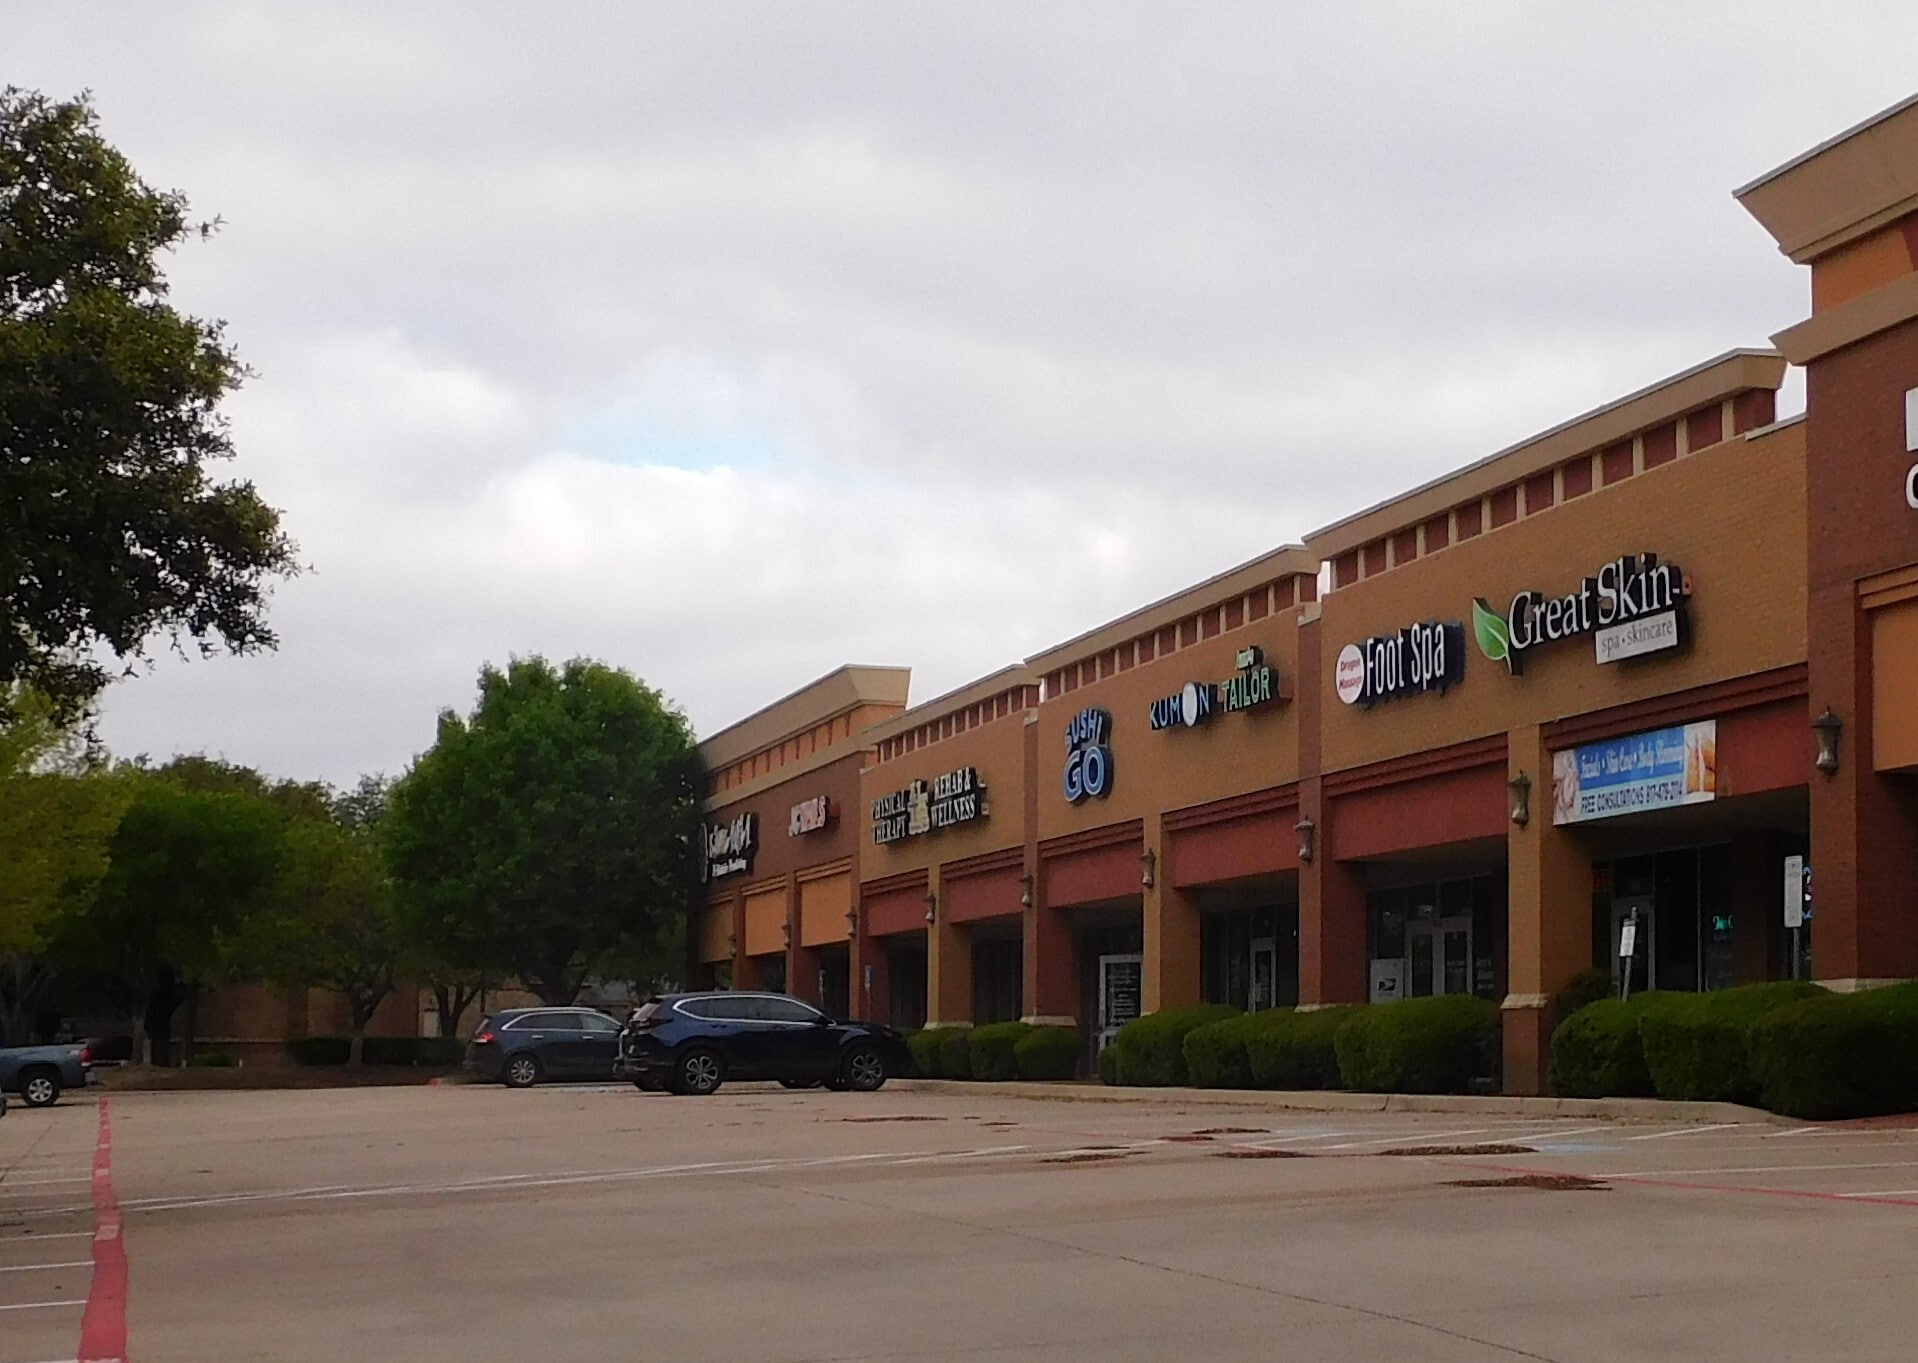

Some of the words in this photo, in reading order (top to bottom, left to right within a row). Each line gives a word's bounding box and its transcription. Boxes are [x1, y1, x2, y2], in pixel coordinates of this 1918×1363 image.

[1508, 577, 1591, 649] Great
[1366, 629, 1405, 697] Foot
[1411, 622, 1444, 691] Spa
[1602, 635, 1620, 658] spa
[1626, 619, 1674, 647] skincare
[1149, 680, 1209, 729] KUMON
[1221, 667, 1271, 713] TAILOR
[1065, 708, 1103, 757] SUSHI
[934, 769, 963, 801] REHAB
[1064, 746, 1105, 802] GO
[931, 794, 976, 828] WELLNESS
